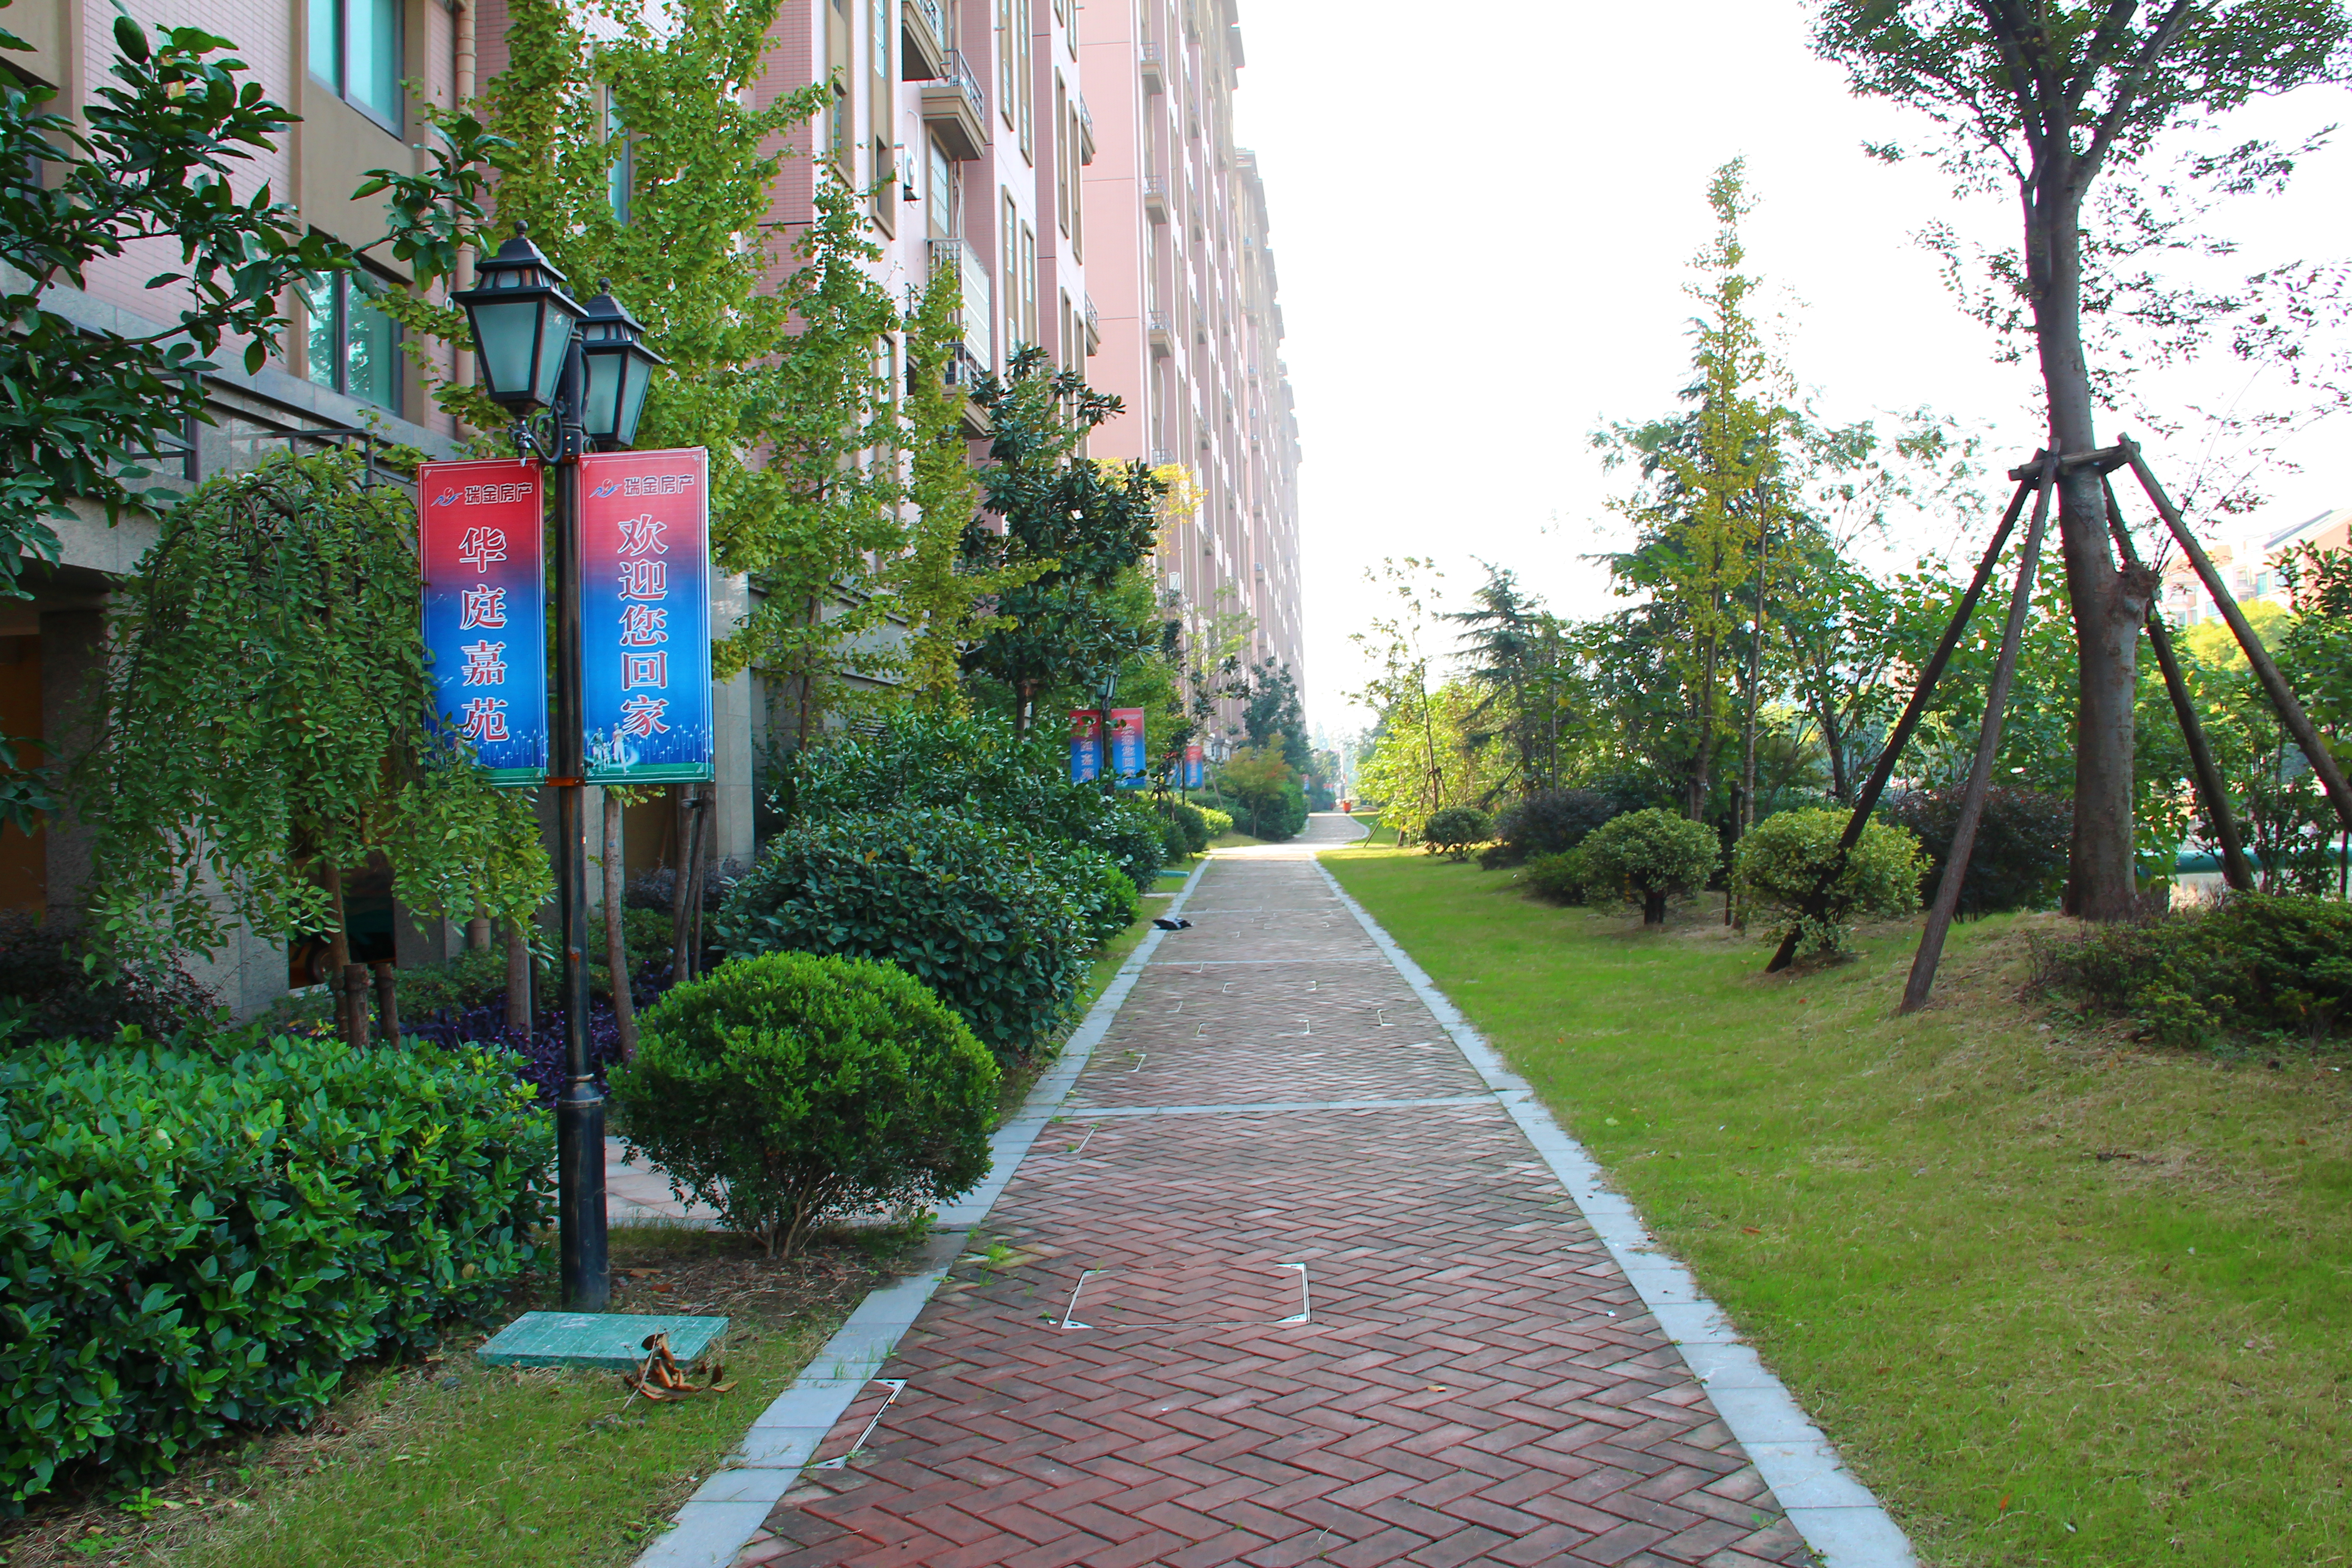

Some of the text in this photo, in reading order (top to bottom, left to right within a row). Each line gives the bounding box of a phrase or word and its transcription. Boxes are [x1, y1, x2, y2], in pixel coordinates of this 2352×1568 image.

[465, 482, 533, 505] 瑞金房产
[624, 474, 694, 496] 瑞金房产
[458, 526, 509, 742] 华庭嘉苑
[617, 514, 670, 738] 欢迎您回家
